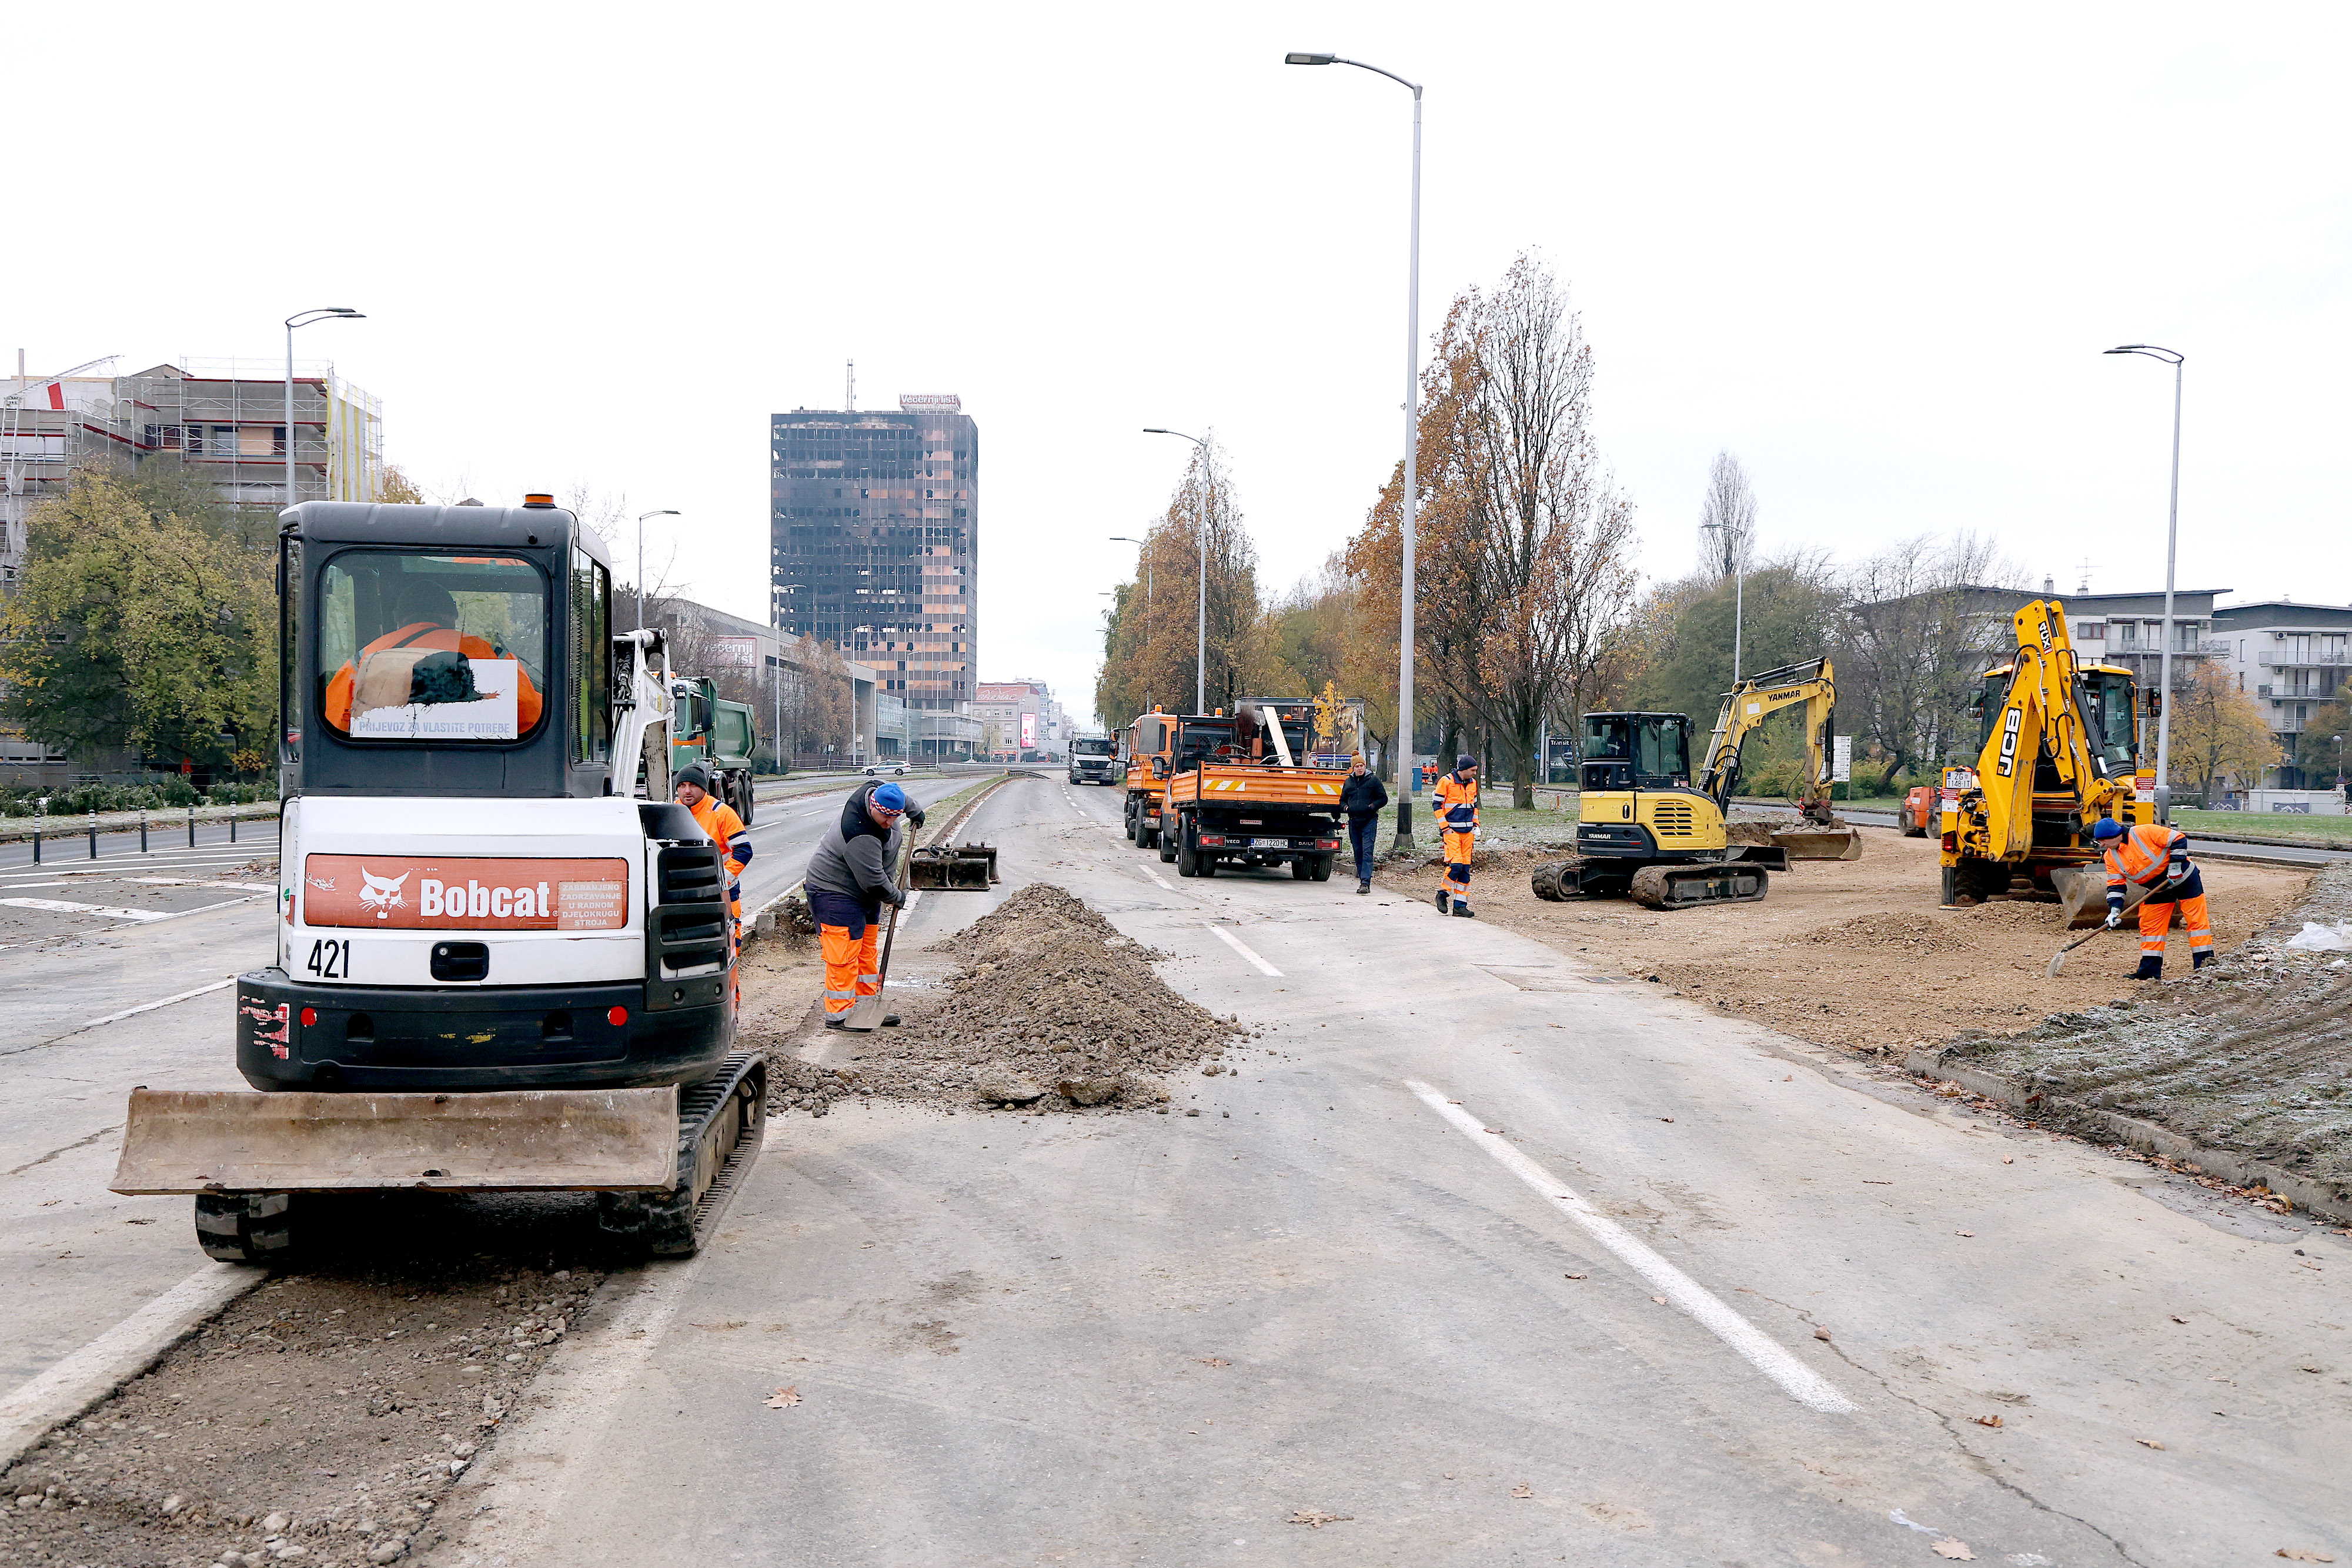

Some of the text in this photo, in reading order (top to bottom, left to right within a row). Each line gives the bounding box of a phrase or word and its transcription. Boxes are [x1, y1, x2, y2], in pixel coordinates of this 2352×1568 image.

[941, 394, 956, 403] list
[2039, 622, 2051, 648] 4CX
[1768, 690, 1800, 702] YANMAR
[359, 721, 405, 732] PRIJEVOZ
[407, 721, 420, 733] ZA
[1999, 709, 2022, 776] JCB
[420, 878, 550, 918] Bobcat
[562, 910, 619, 918] DJELOKRUGU
[308, 939, 350, 978] 421
